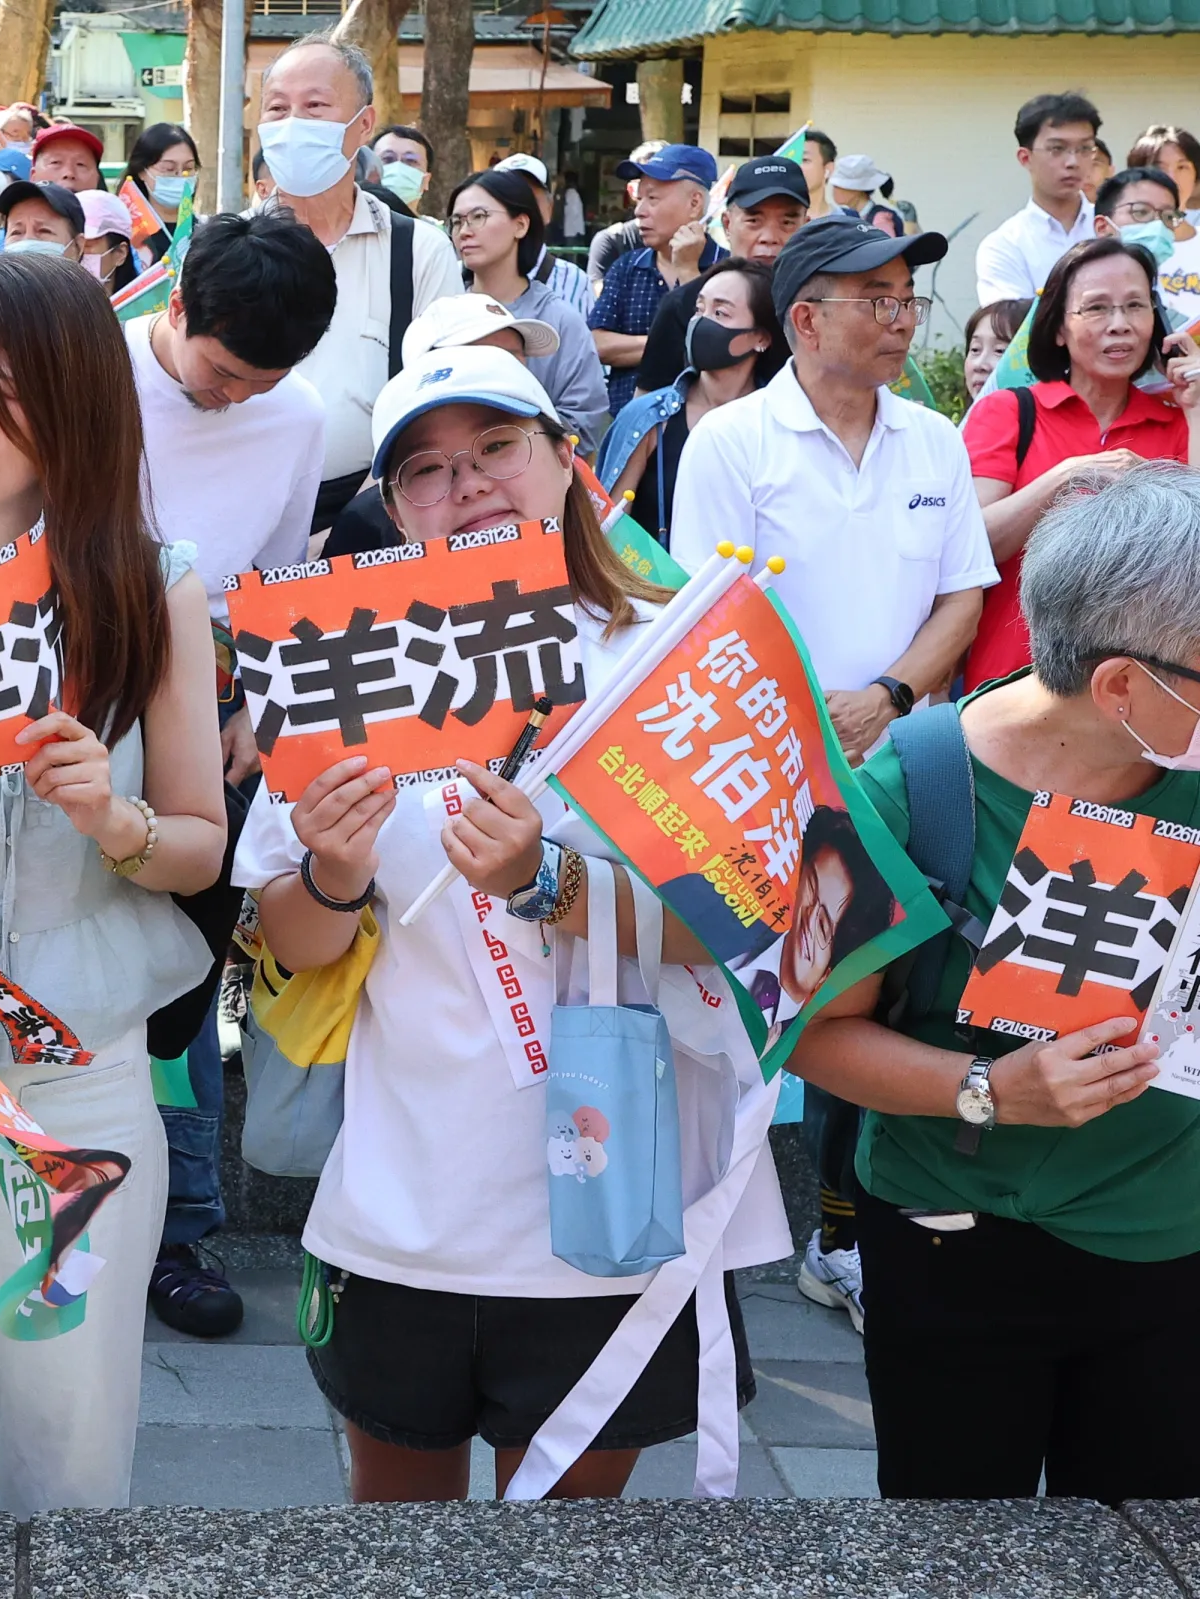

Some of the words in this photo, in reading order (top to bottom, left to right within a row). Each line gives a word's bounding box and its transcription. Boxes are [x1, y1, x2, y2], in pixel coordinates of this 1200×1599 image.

[262, 560, 331, 585] 20261128
[355, 543, 425, 569] 20261128
[449, 525, 519, 552] 20261128
[235, 579, 586, 757] 洋流
[597, 744, 711, 860] 台北順起來
[636, 671, 803, 885] 沈伯洋
[1071, 800, 1134, 828] 20261128
[1154, 820, 1200, 846] 202611
[704, 869, 754, 920] SOON
[717, 860, 760, 913] FUTURE
[991, 1017, 1057, 1042] 20261128
